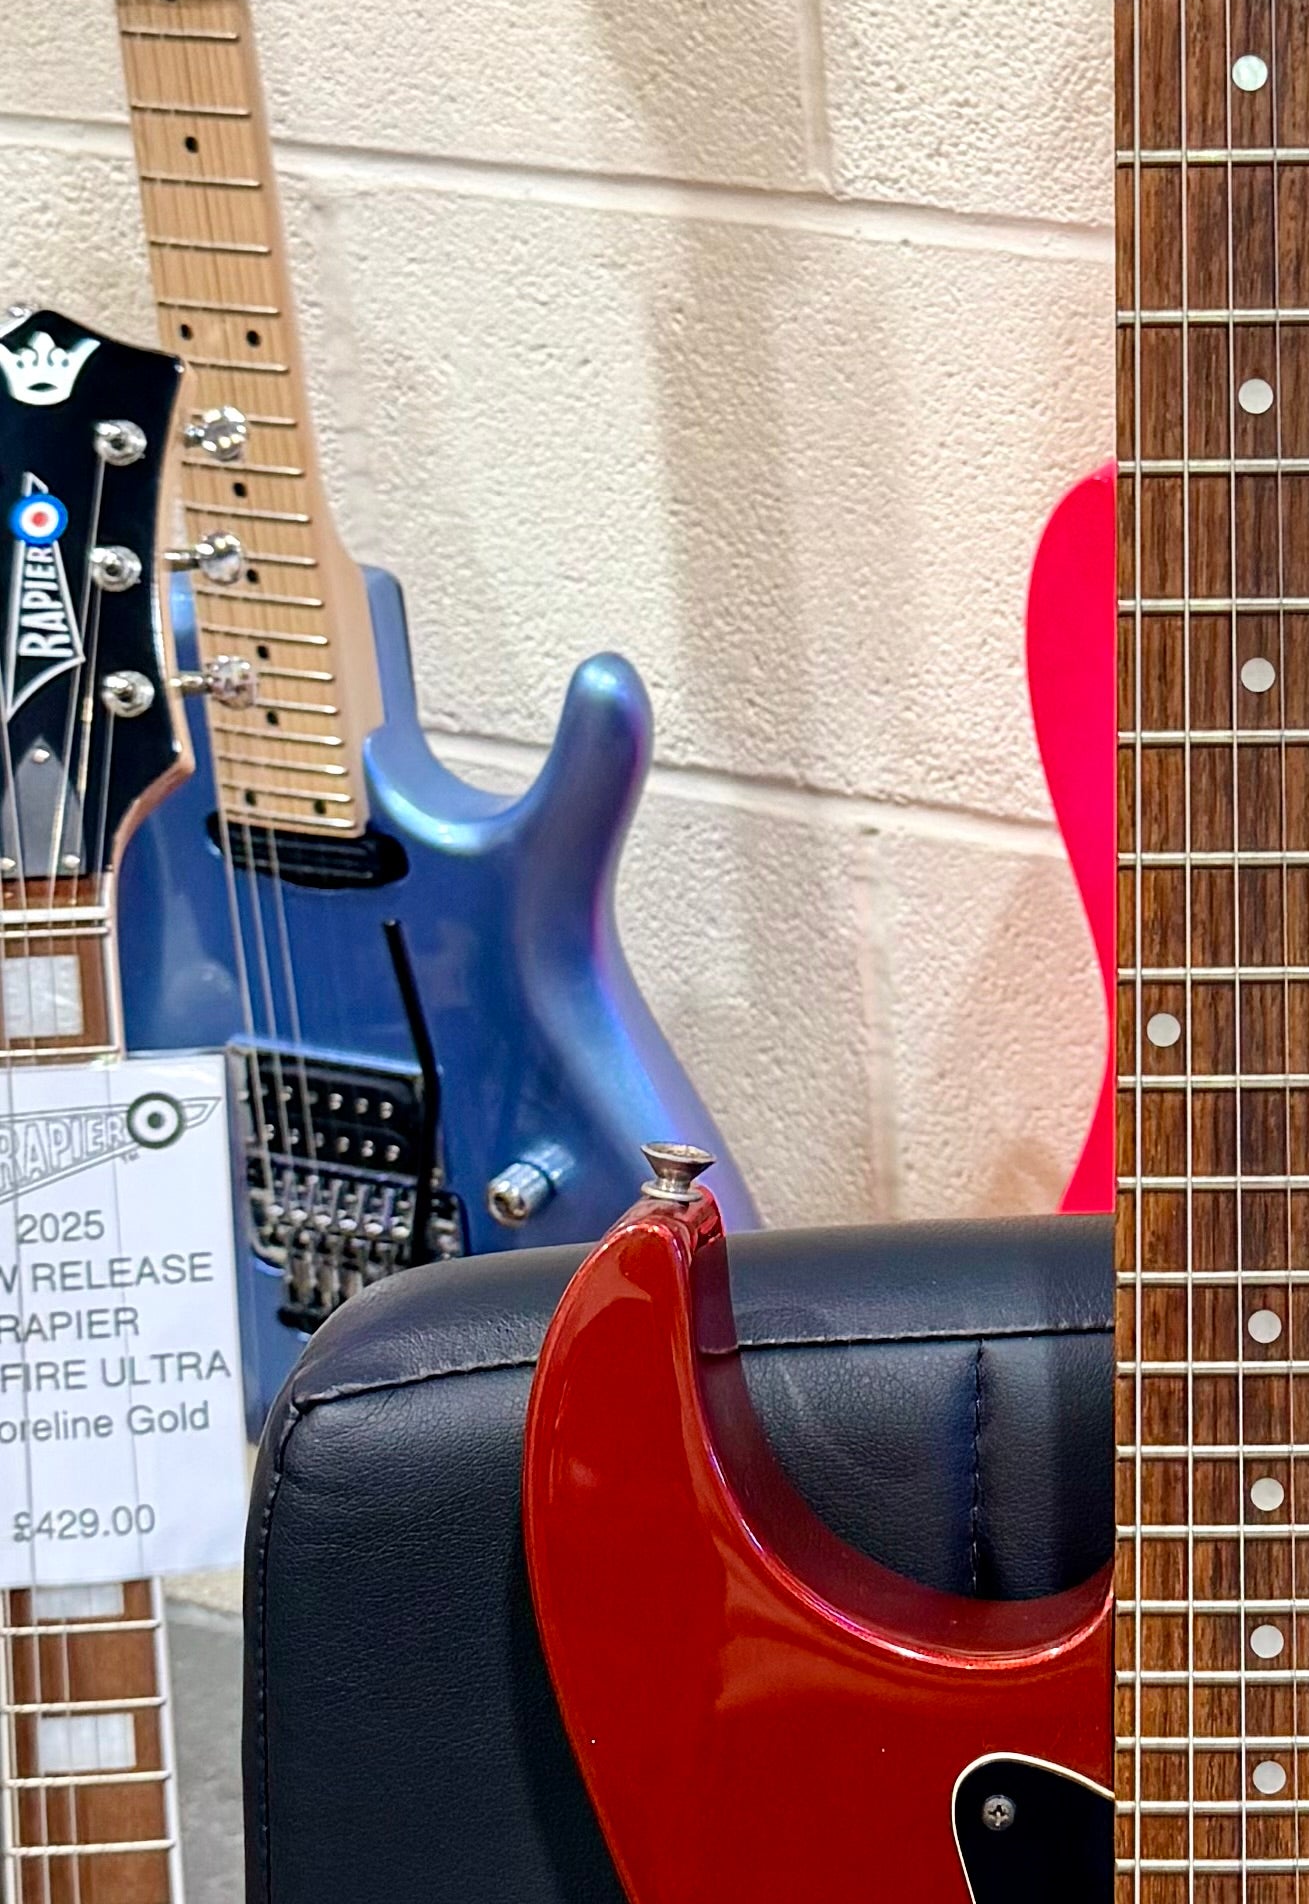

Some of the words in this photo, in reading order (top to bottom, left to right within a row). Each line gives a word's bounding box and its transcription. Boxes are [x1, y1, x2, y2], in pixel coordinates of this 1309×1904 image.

[18, 546, 74, 658] RAPIER
[17, 1209, 105, 1244] 2025
[31, 1251, 214, 1293] RELEASE
[100, 1349, 232, 1388] ULTRA
[126, 1399, 210, 1435] Gold
[12, 1503, 156, 1542] £429.00
